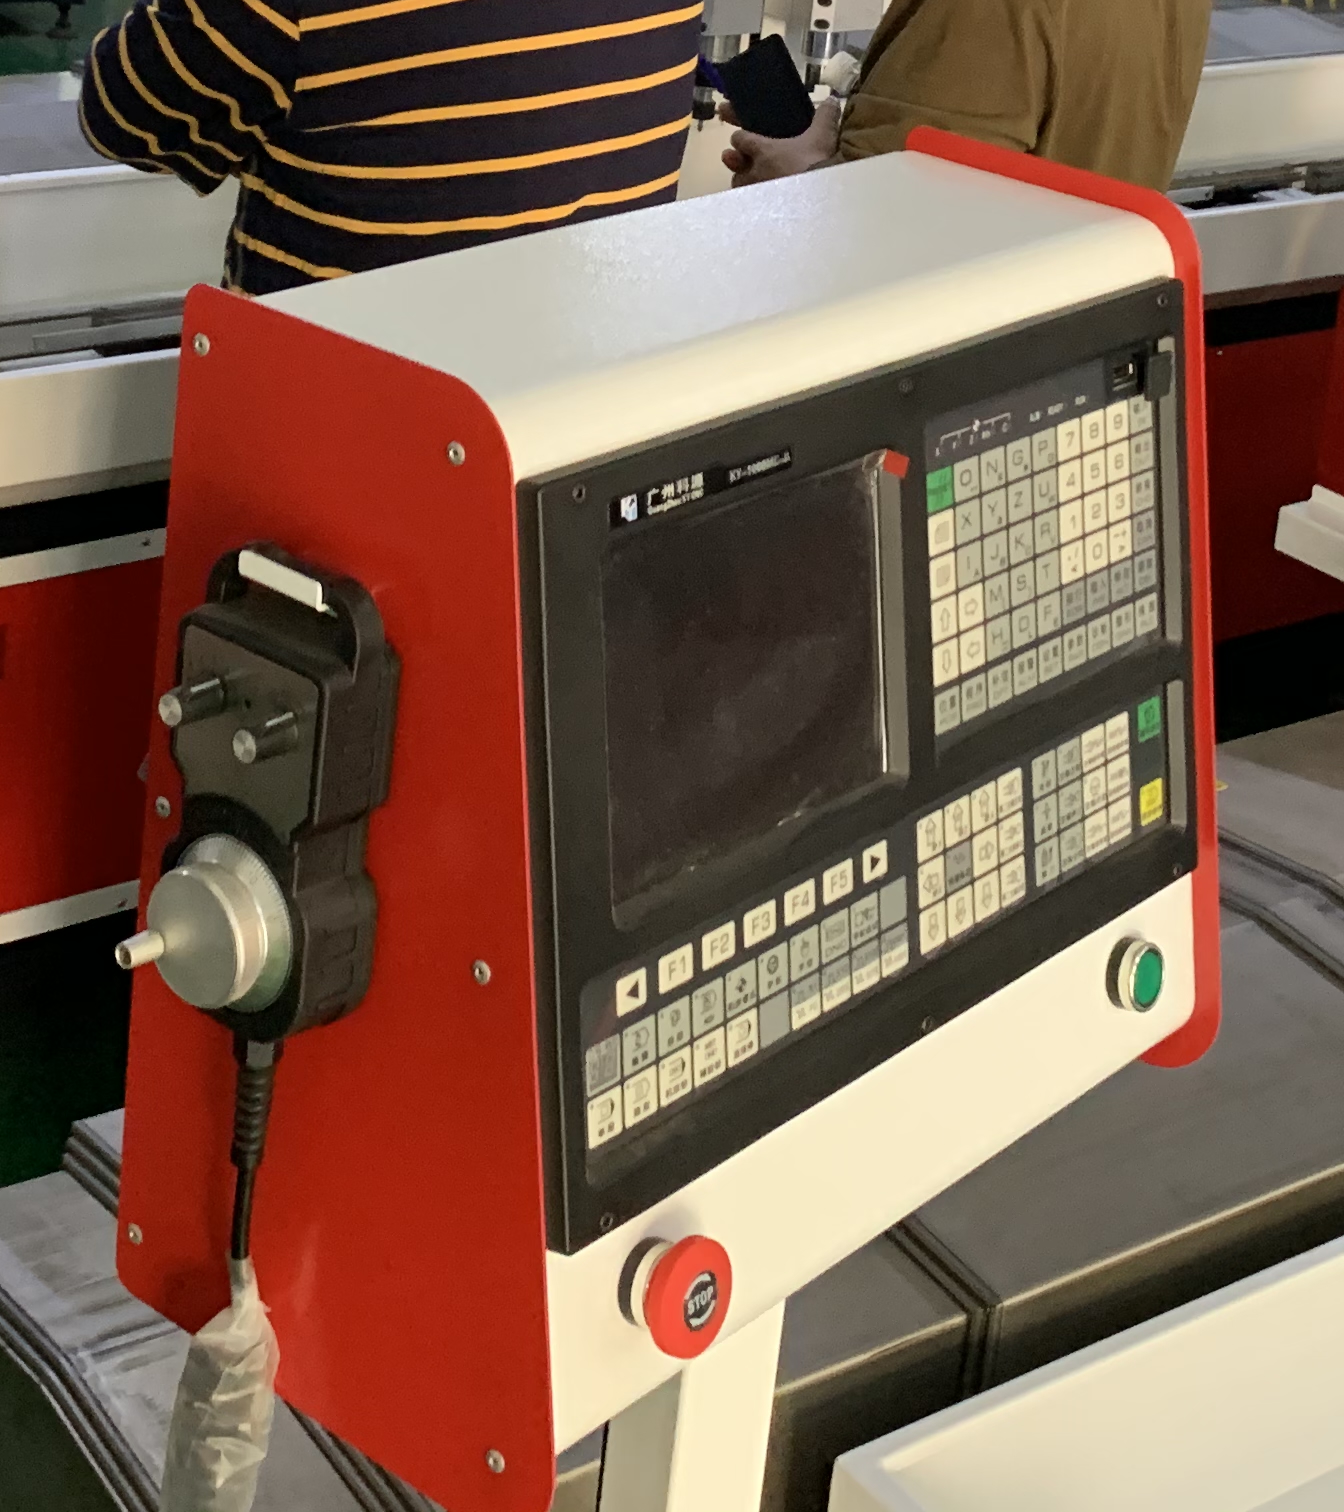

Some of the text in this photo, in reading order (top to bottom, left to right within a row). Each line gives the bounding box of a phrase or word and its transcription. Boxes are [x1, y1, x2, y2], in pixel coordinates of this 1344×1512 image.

[830, 869, 849, 895] F5
[790, 889, 811, 915] F4
[750, 910, 772, 938] F3
[709, 932, 731, 960] F2
[667, 955, 688, 982] F1
[686, 1285, 714, 1316] STOP
